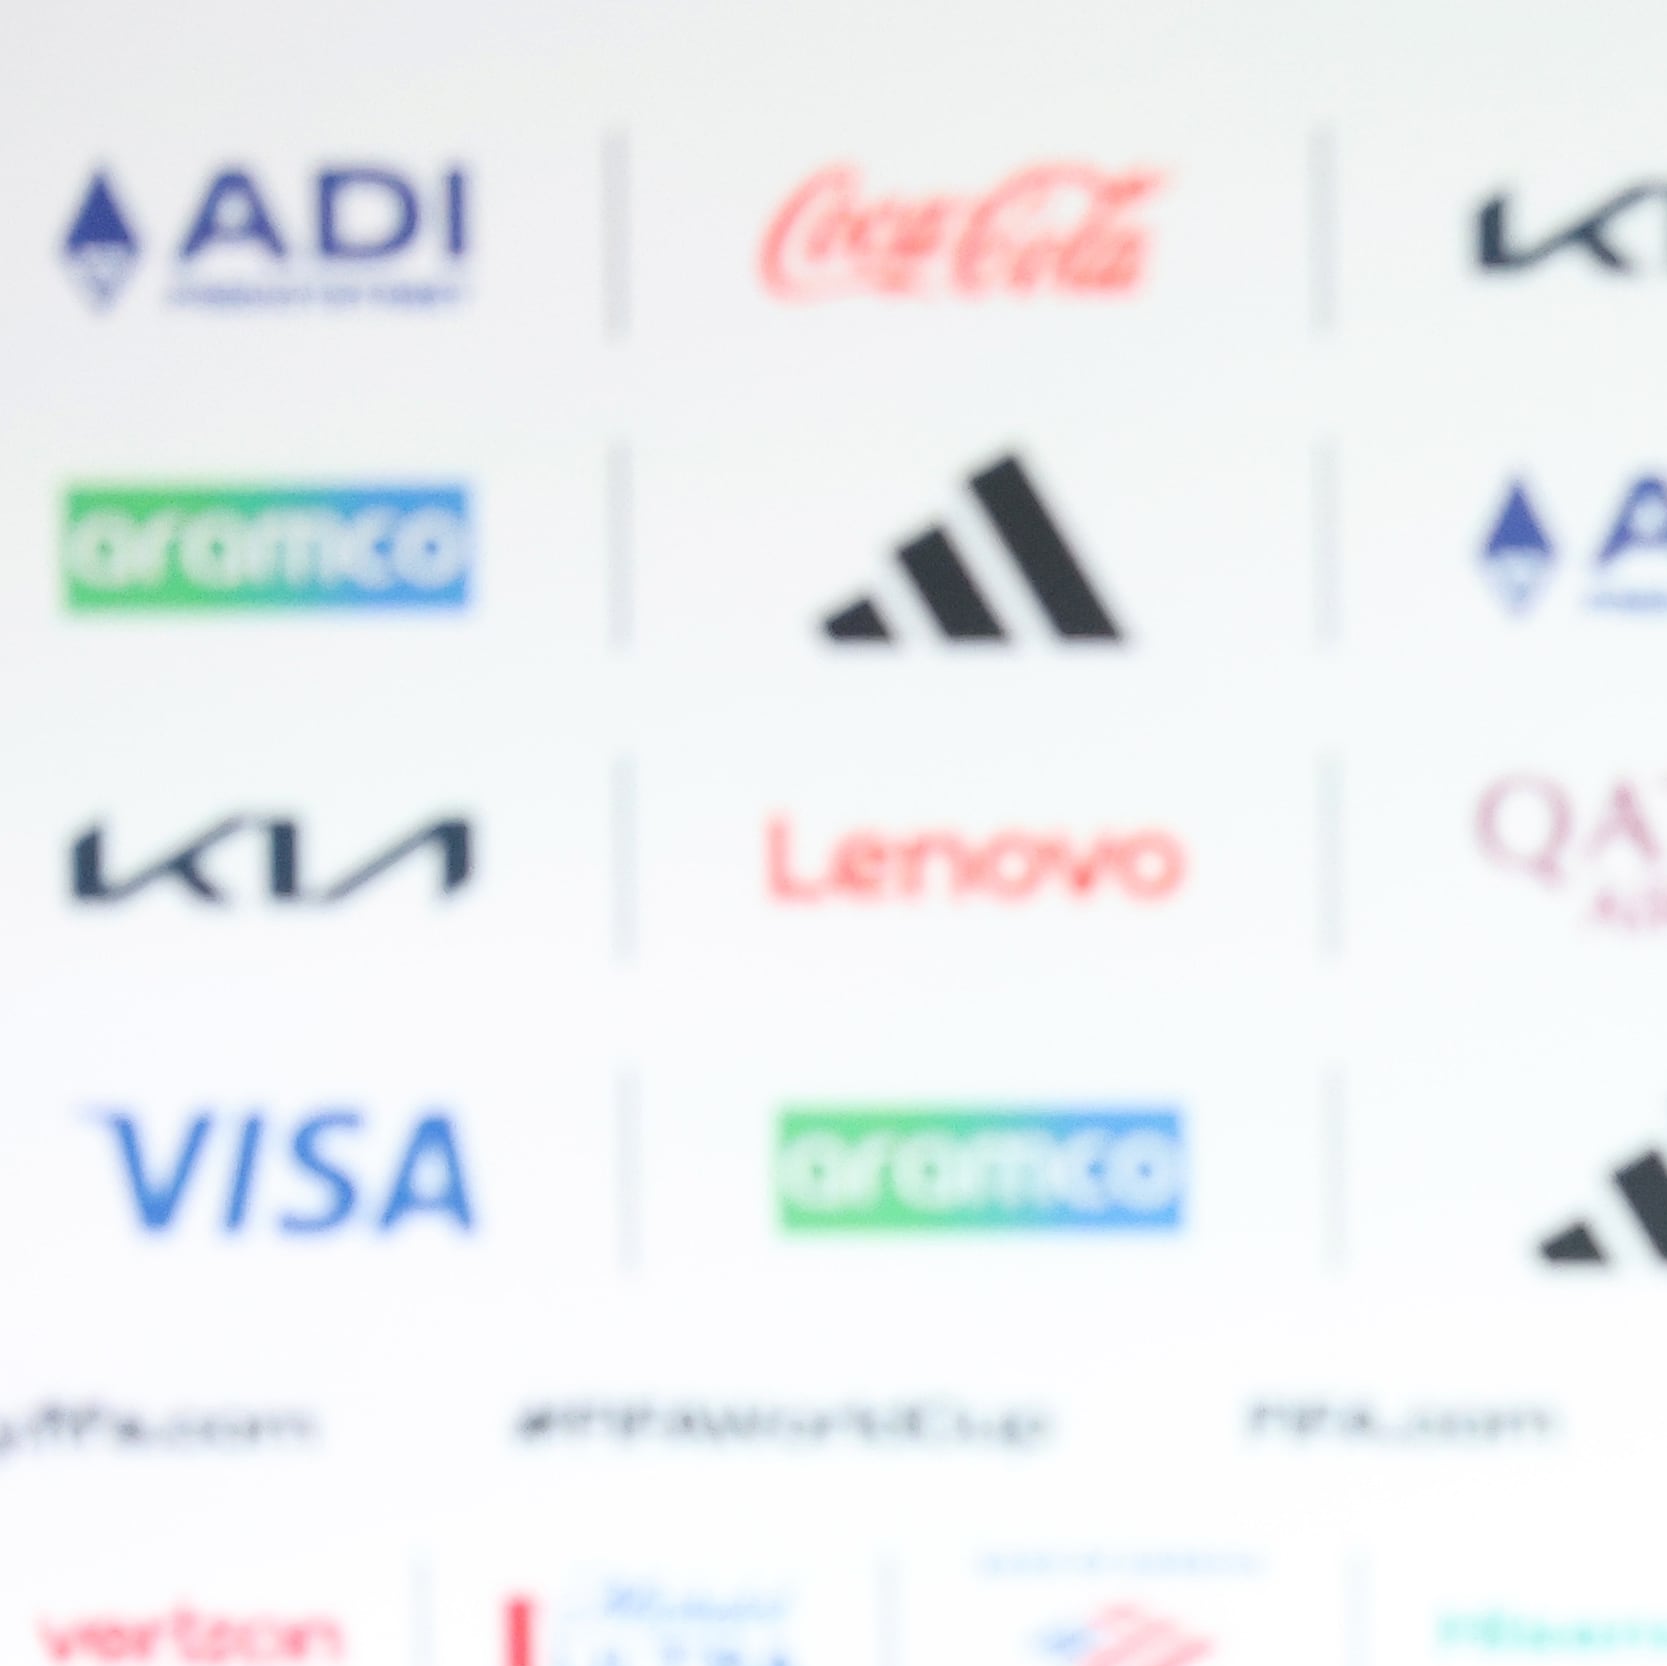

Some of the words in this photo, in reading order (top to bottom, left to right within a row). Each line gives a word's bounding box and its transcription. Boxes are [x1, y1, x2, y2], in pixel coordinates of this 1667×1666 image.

[178, 164, 470, 262] ADI
[72, 505, 469, 587] aramco
[66, 813, 477, 907] KIA
[764, 814, 1189, 906] Lenovo
[97, 1106, 478, 1238] VISA
[783, 1128, 1180, 1214] aramco
